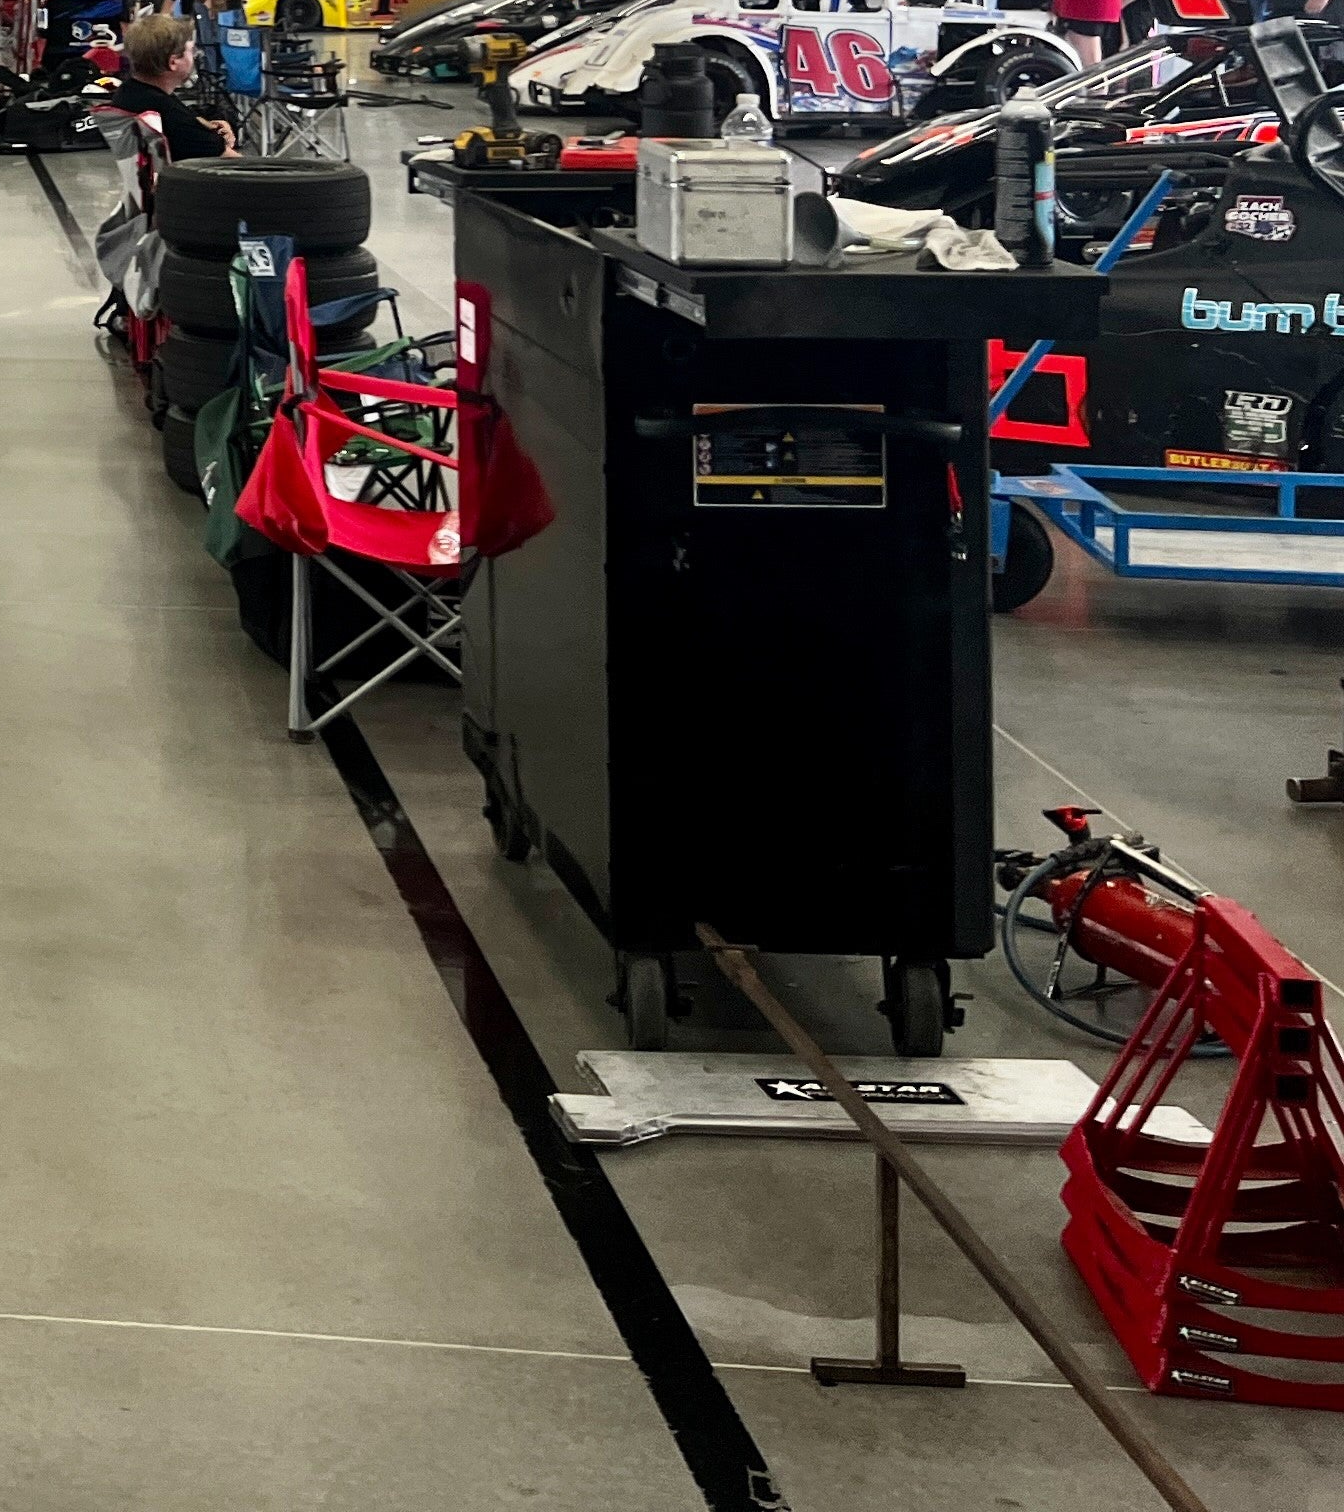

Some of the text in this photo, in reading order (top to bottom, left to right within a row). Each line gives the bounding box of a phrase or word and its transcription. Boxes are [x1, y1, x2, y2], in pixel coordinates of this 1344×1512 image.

[781, 24, 896, 103] 46
[1239, 201, 1280, 211] ZACH
[799, 1082, 941, 1093] ASTAR
